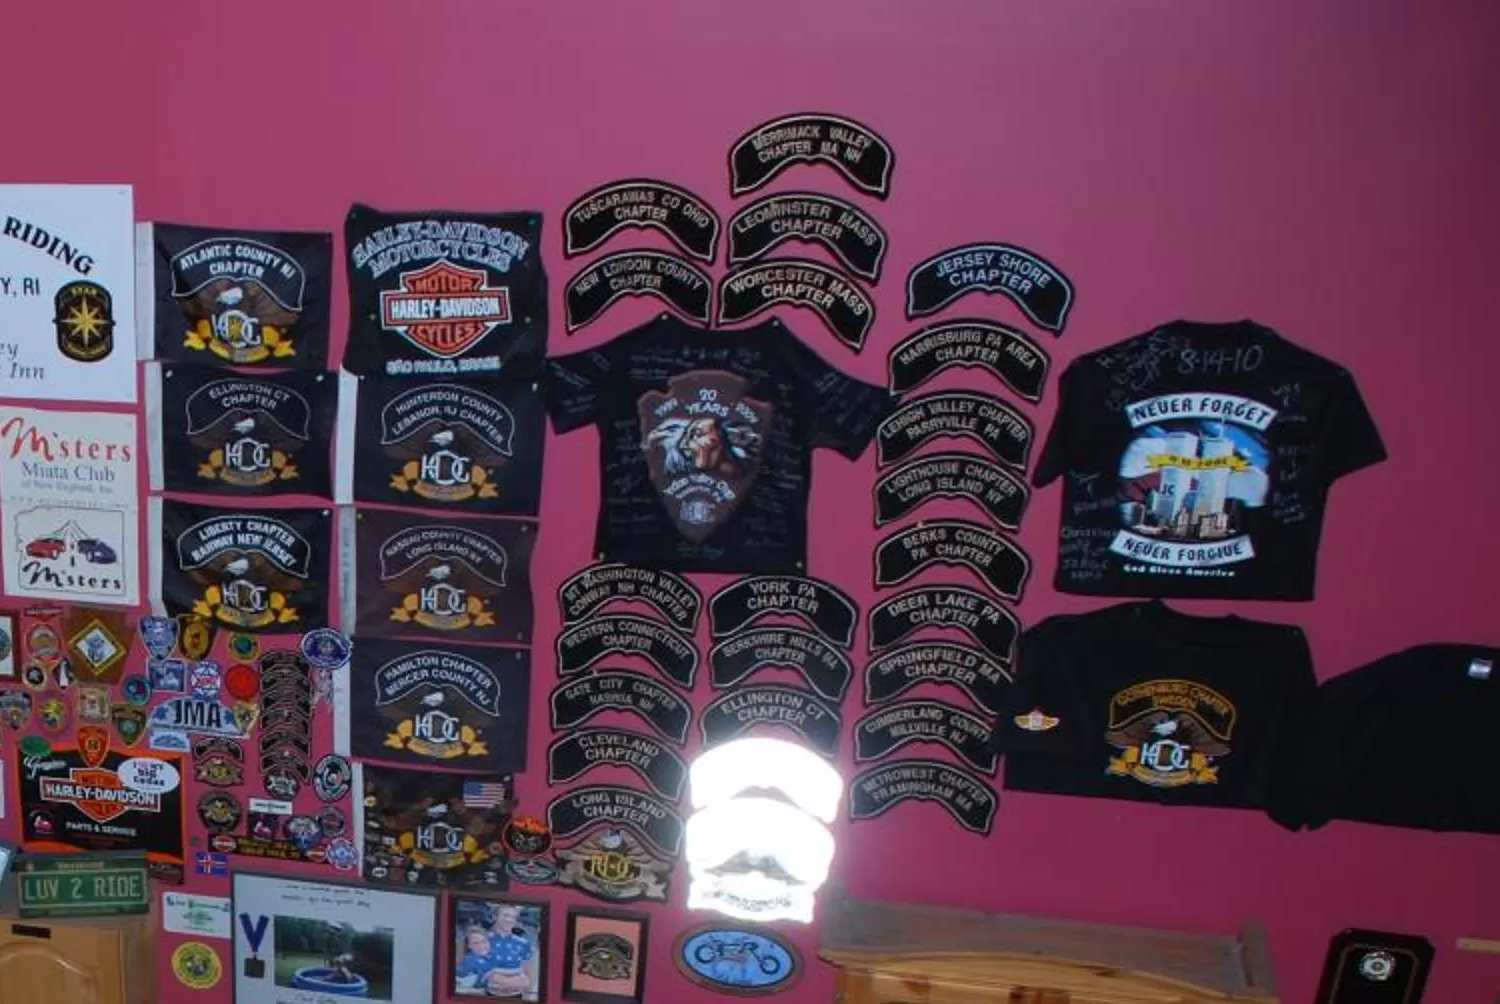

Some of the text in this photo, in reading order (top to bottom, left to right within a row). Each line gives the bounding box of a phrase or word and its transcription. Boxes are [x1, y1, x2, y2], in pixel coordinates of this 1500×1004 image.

[752, 125, 872, 151] MERRIMACK VALLEY
[757, 140, 812, 163] CHAPTER
[614, 205, 668, 222] CHAPTER
[735, 200, 878, 247] LEOMINSTER MASS
[770, 218, 844, 240] CHAPTER
[3, 216, 96, 276] RIDING
[352, 220, 530, 269] HARLEY-DAVIDSON
[179, 245, 233, 273] ATLANTIC
[235, 245, 281, 270] COUNTY
[208, 261, 265, 279] CHAPTER
[368, 240, 512, 280] MOTORCYCLES
[936, 252, 1052, 289] JERSEY SHORE
[23, 277, 41, 296] RI
[414, 273, 476, 294] MOTOR
[575, 257, 704, 296] NEW LONDON COUNTY
[609, 272, 662, 290] CHAPTER
[949, 269, 1033, 295] CHAPTER
[728, 267, 866, 317] WORCESTER MASS
[761, 283, 834, 310] CHAPTER
[391, 297, 501, 321] HARLEY-DAVIDSON
[416, 321, 477, 347] CYCLES
[900, 329, 1038, 370] HARRISBURG PA AREA
[935, 346, 1000, 363] CHAPTER
[10, 361, 46, 380] Inn
[221, 394, 278, 411] CHAPTER
[1134, 396, 1270, 425] NEVER FORGET
[880, 400, 1029, 442] LEHIGH VALLEY CHAPTER
[21, 461, 116, 483] Miata Club
[885, 461, 1020, 498] LIGHTHOUSE CHAPTER
[898, 476, 1005, 505] LONG ISLAND NY
[200, 520, 297, 548] LIBERTY CHAPTER
[902, 528, 1005, 556] BERKS COUNTY
[911, 542, 994, 568] PA CHAPTER
[1123, 538, 1245, 562] NEVER FORGIVE
[749, 582, 816, 598] YORK PA
[747, 597, 820, 613] CHAPTER
[888, 593, 1002, 625] DEER LAKE PA
[909, 607, 980, 628] CHAPTER
[601, 635, 652, 651] CHAPTER
[755, 648, 805, 664] CHAPTER
[384, 655, 491, 690] HAMILTON CHAPTER
[878, 650, 1002, 686] SPRINGFIELD MA
[904, 663, 977, 686] CHAPTER
[721, 691, 824, 721] ELLINGTON CT
[737, 707, 806, 724] CHAPTER
[865, 708, 992, 743] CUMBERLAND COUNTY
[579, 735, 660, 757] CLEVELAND
[585, 746, 650, 768] CHAPTER
[45, 783, 156, 805] HARLEY-DAVIDSON
[572, 792, 666, 819] LONG ISLAND
[583, 805, 649, 825] CHAPTER
[25, 876, 140, 901] LUV 2 RIDE
